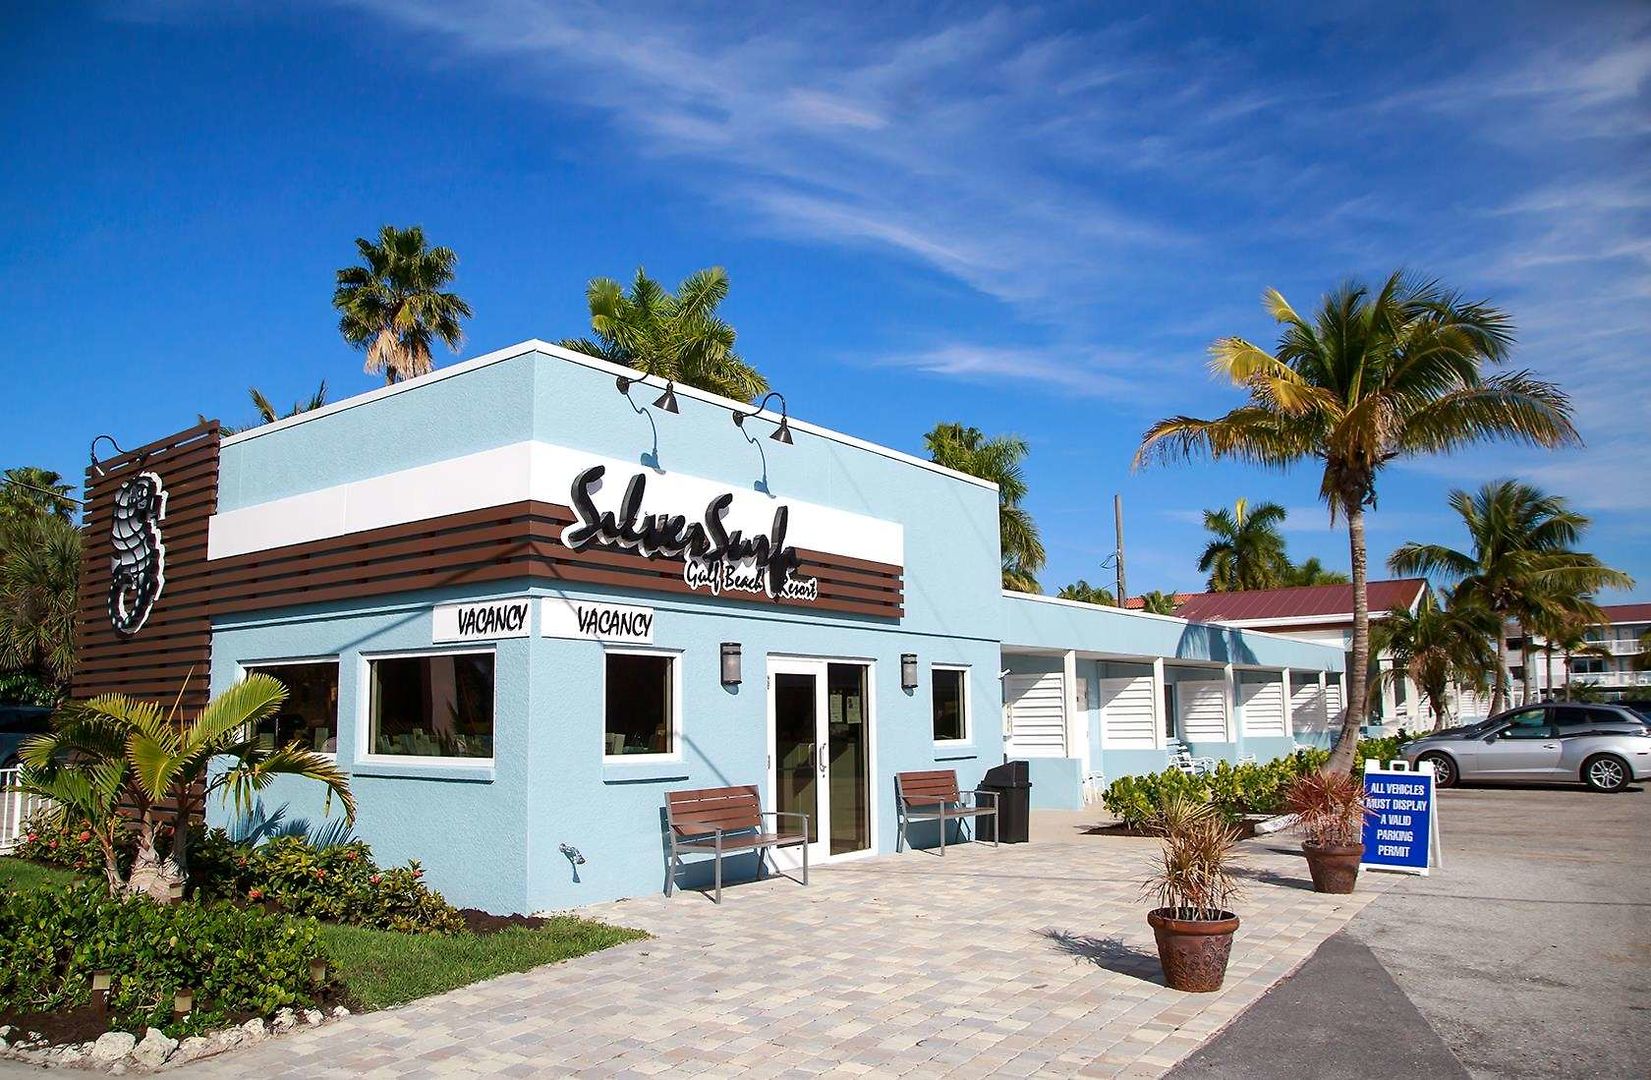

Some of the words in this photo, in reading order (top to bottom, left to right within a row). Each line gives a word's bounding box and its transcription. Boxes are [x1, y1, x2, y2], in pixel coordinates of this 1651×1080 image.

[569, 465, 711, 557] Silver
[701, 493, 801, 602] Surf
[686, 560, 720, 593] Gulf
[724, 565, 765, 591] Beach
[458, 603, 528, 636] VACANCY
[577, 606, 653, 637] VACANCY
[1371, 783, 1385, 794] ALL
[1386, 783, 1425, 795] VEHICLES
[1366, 798, 1391, 809] MUST
[1393, 799, 1428, 811] DISPLAY
[1380, 814, 1387, 825] A
[1388, 814, 1412, 826] VALID
[1376, 829, 1414, 842] PARKING
[1377, 845, 1411, 858] PERMIT
